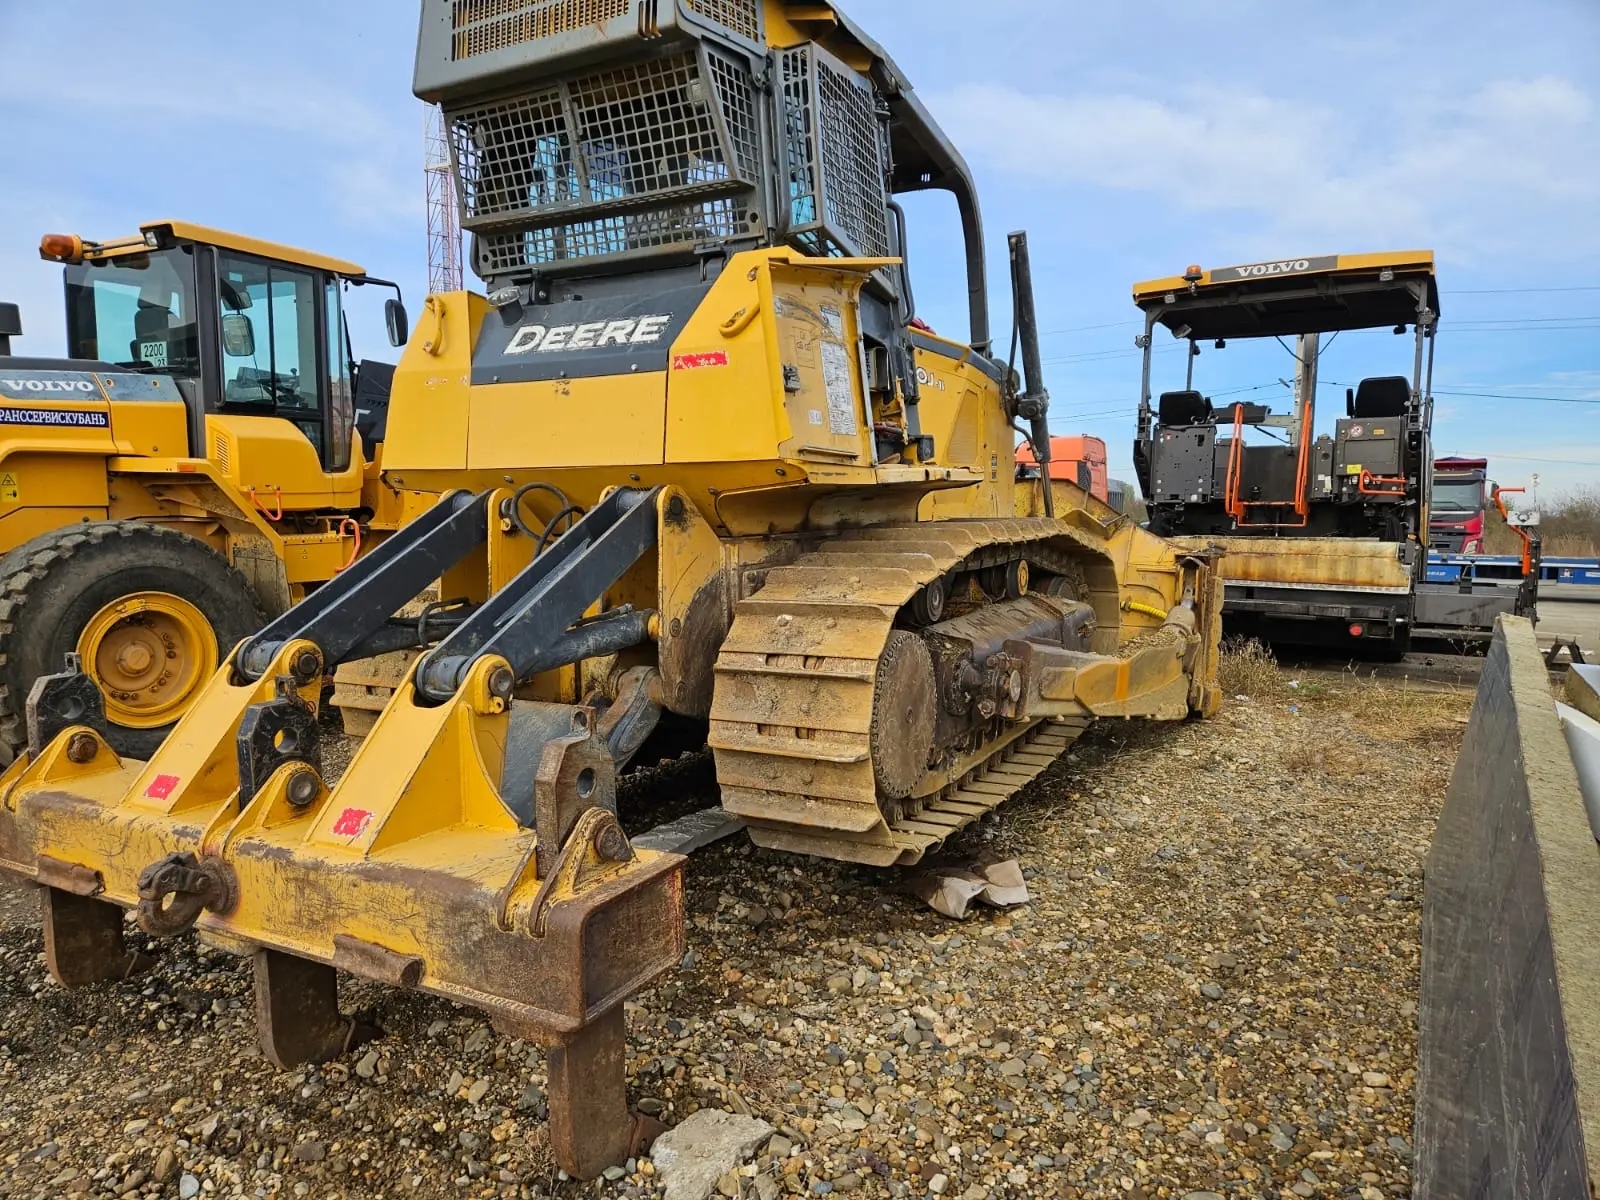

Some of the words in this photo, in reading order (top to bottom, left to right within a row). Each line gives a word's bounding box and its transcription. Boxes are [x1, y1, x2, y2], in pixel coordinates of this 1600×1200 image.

[1235, 259, 1309, 277] VOLVO
[502, 314, 672, 356] DEERE
[143, 343, 164, 358] 2200
[3, 380, 95, 392] VOLVO
